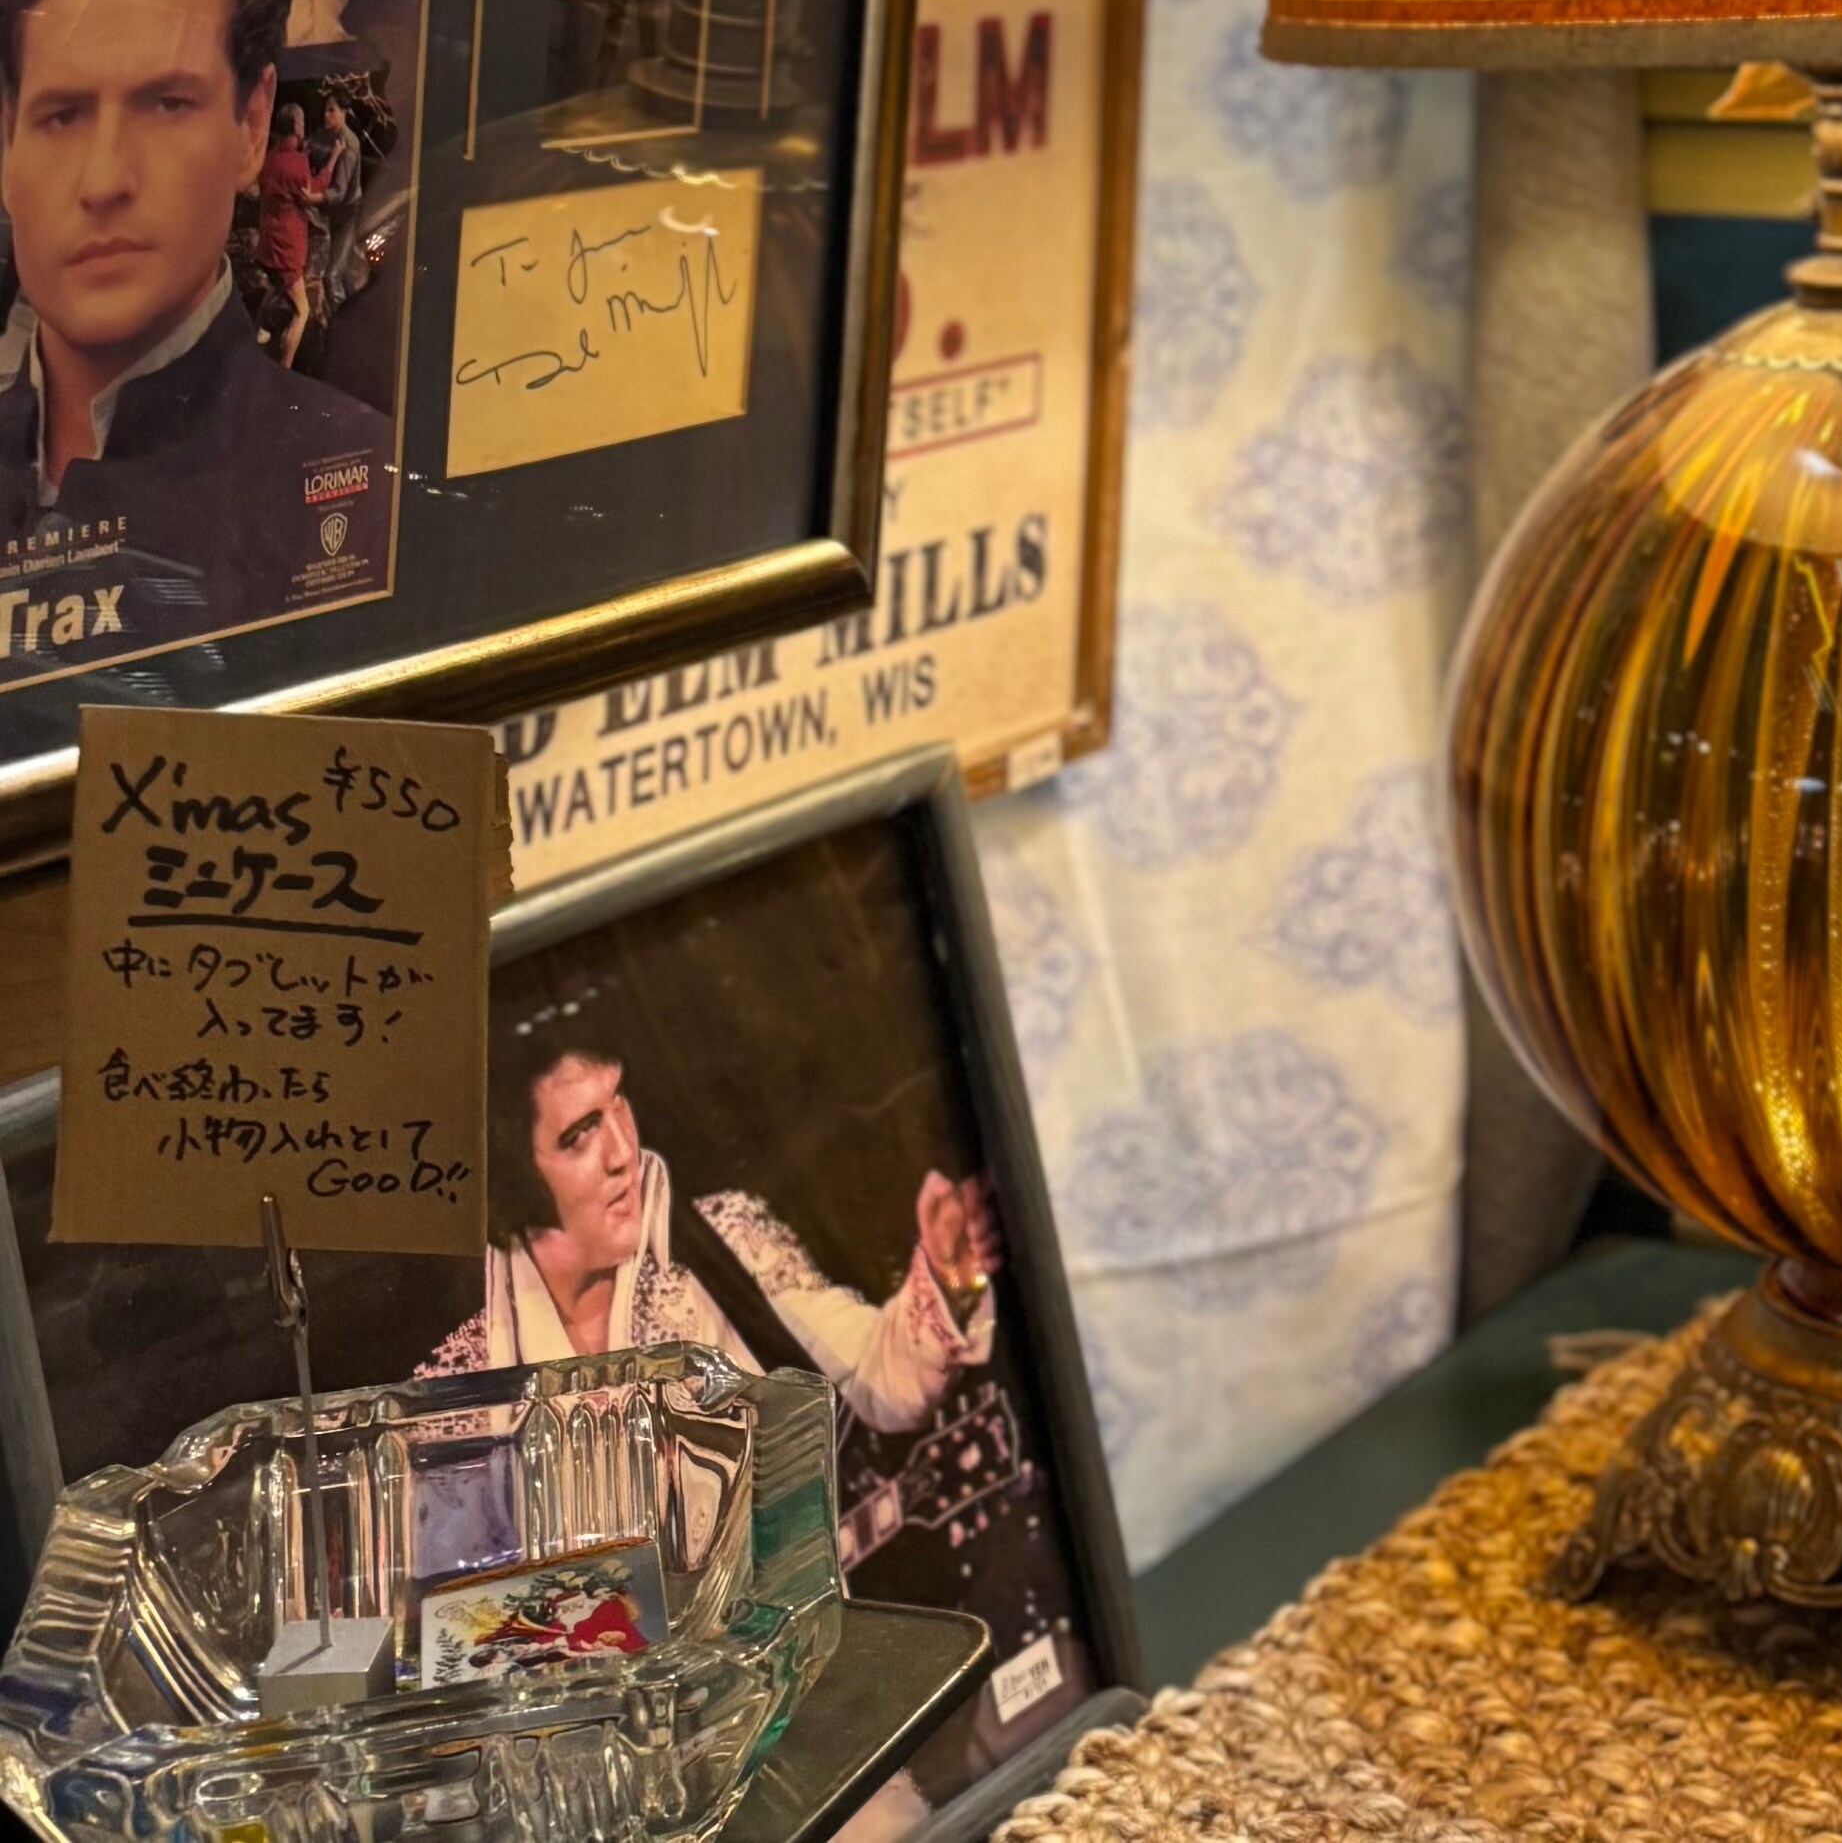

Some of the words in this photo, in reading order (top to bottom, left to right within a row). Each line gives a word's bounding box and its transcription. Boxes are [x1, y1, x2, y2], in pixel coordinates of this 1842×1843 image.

[912, 10, 1053, 169] LM
[304, 464, 370, 496] LORIMAR
[6, 515, 128, 556] REMIERE
[0, 584, 125, 659] Trax
[814, 511, 1048, 669] MILLS
[322, 745, 461, 833] ¥550
[515, 687, 837, 846] WATERTOWN,
[861, 653, 938, 727] WIS
[142, 845, 386, 915] ミニケース
